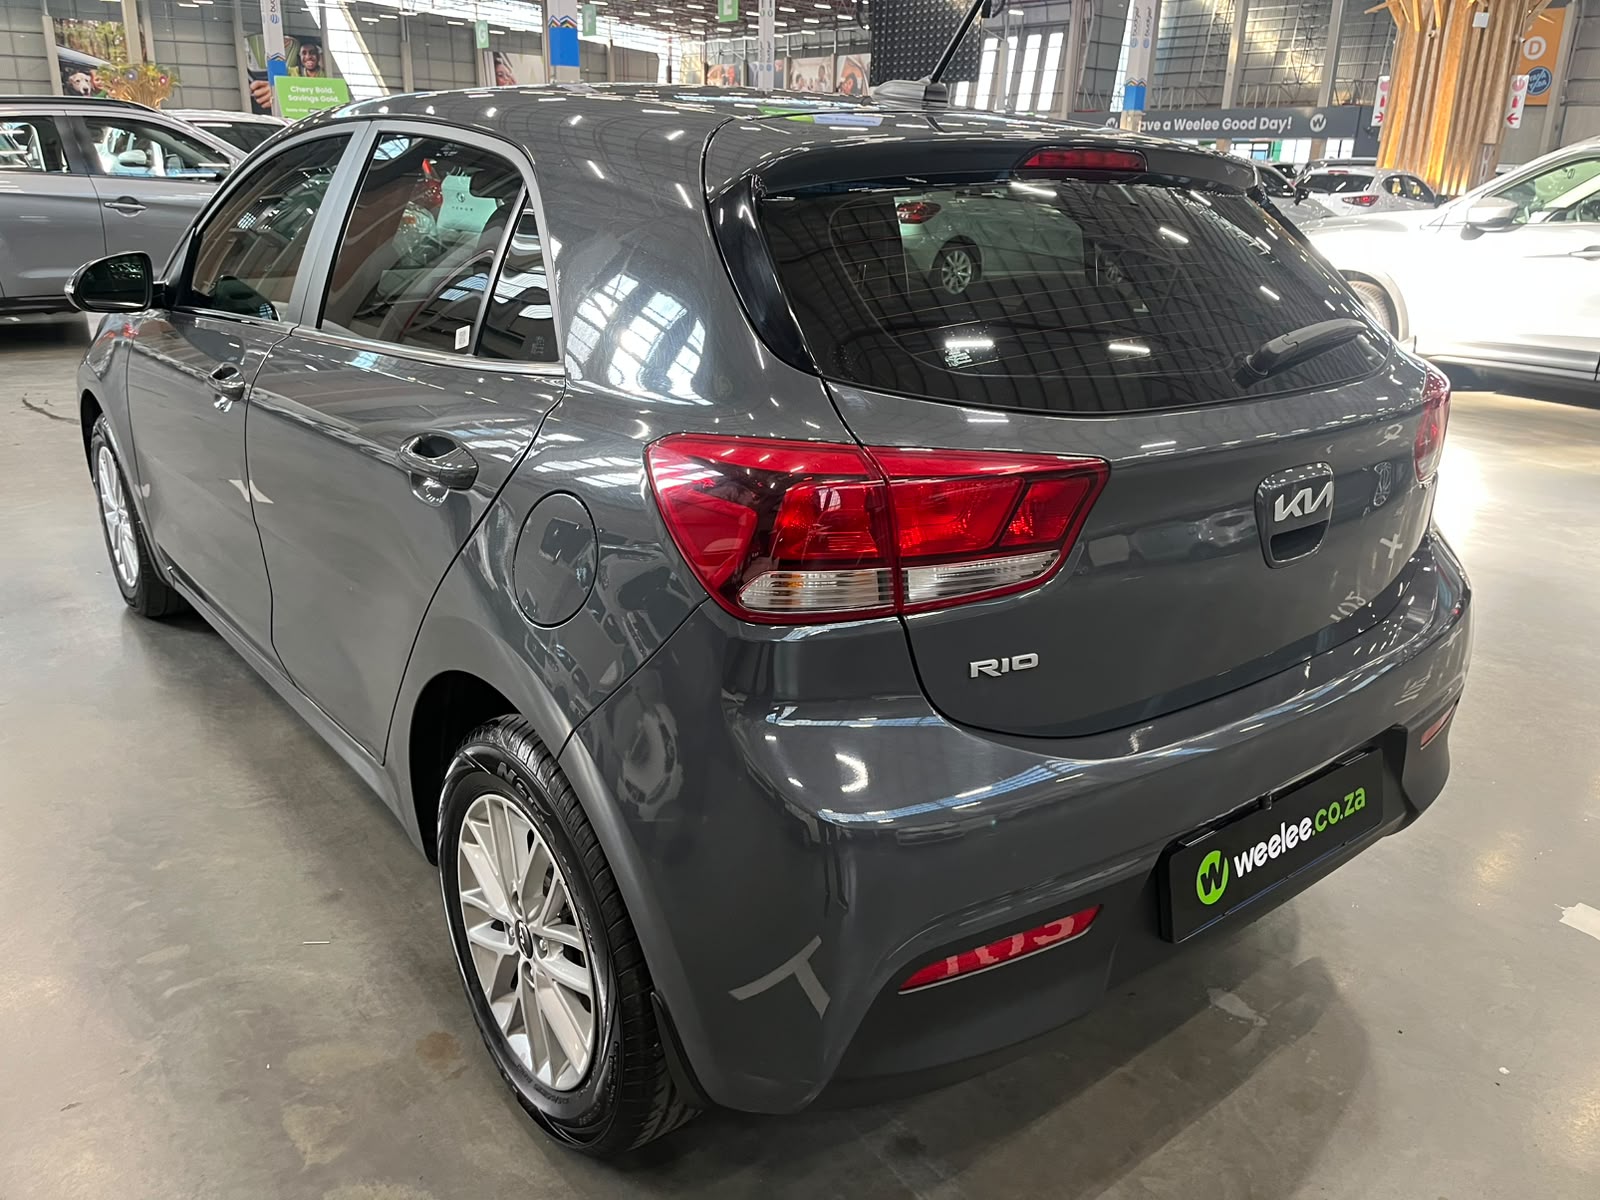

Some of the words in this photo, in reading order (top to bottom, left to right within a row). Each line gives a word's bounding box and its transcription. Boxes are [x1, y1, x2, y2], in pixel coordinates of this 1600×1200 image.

[1528, 40, 1542, 55] D
[287, 94, 319, 103] Savings
[290, 86, 314, 94] Chery
[1139, 119, 1160, 132] ave
[1162, 122, 1171, 131] a
[1173, 118, 1220, 131] Weelee
[1222, 117, 1257, 131] Good
[1259, 116, 1292, 134] Day!
[1274, 481, 1333, 522] KIA
[970, 653, 1039, 678] RIO
[1233, 787, 1366, 878] weelee.co.za
